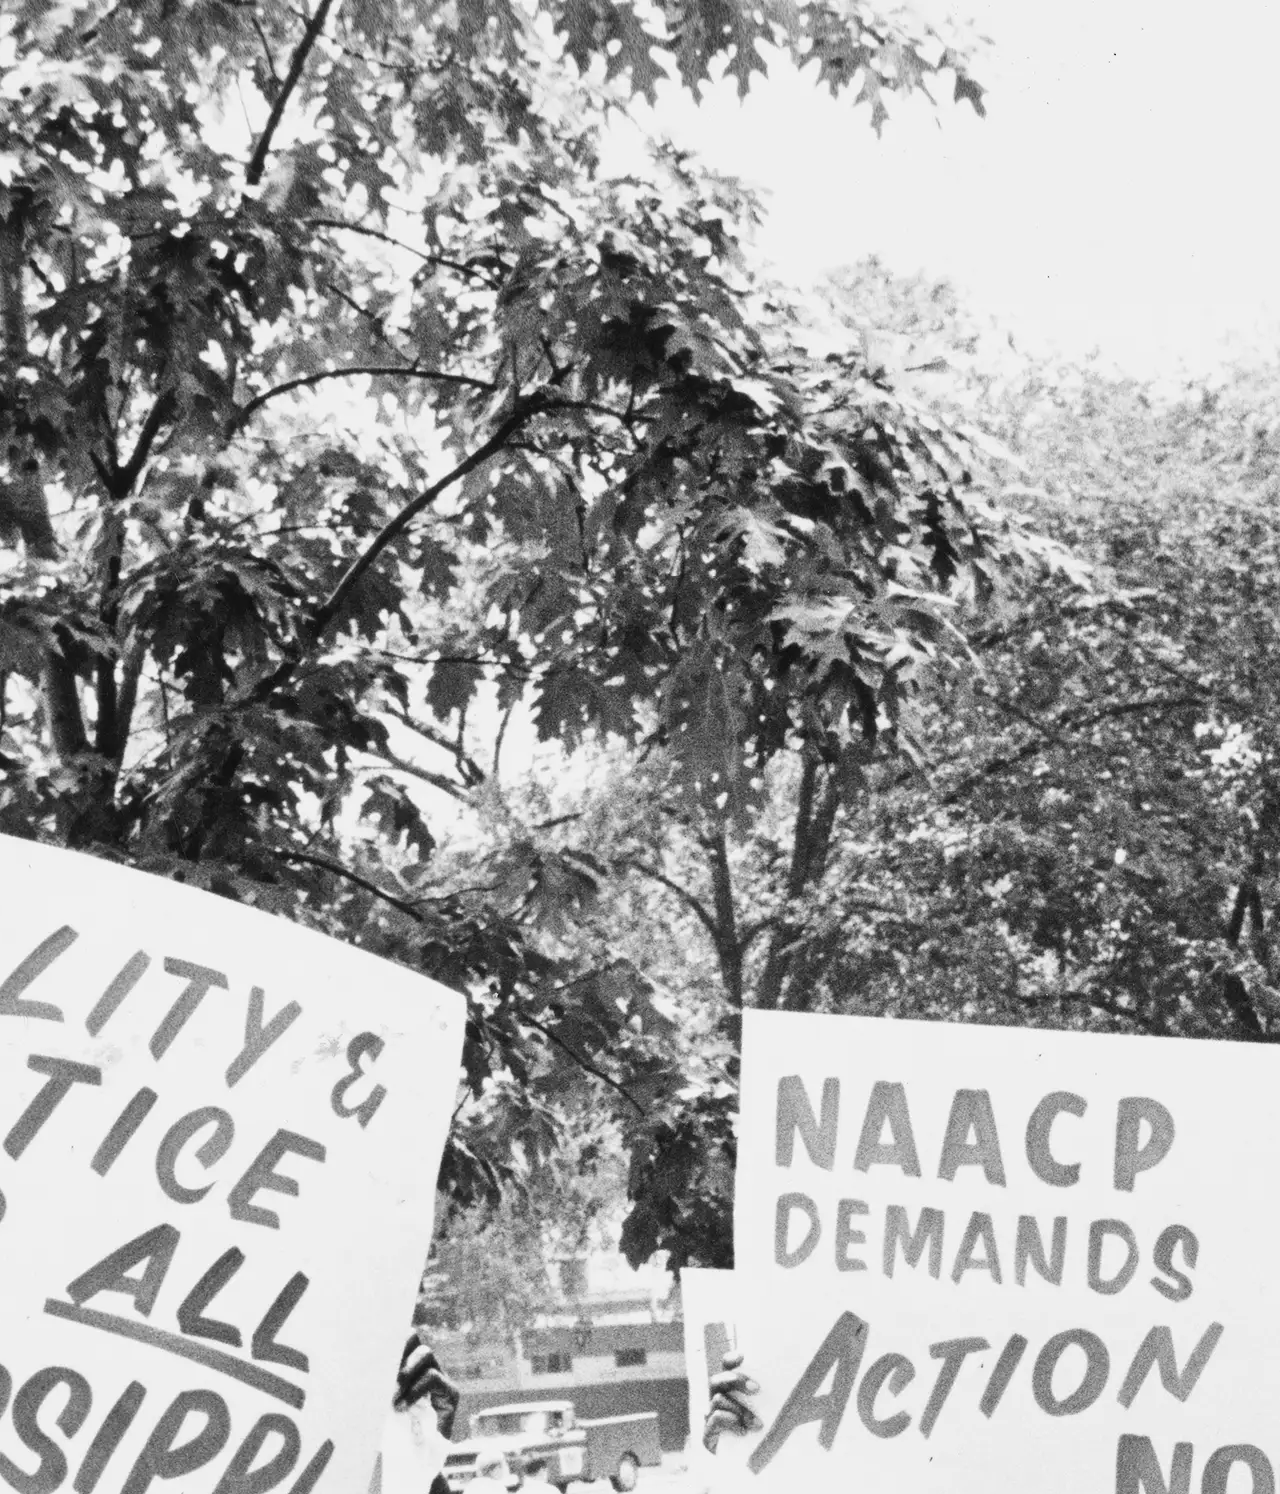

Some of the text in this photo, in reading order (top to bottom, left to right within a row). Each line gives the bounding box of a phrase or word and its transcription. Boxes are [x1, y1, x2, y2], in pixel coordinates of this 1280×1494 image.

[330, 1031, 388, 1129] &
[774, 1073, 1176, 1193] NAACP
[65, 1222, 310, 1374] ALL
[773, 1191, 1200, 1303] DEMANDS
[746, 1310, 1225, 1476] ACTION
